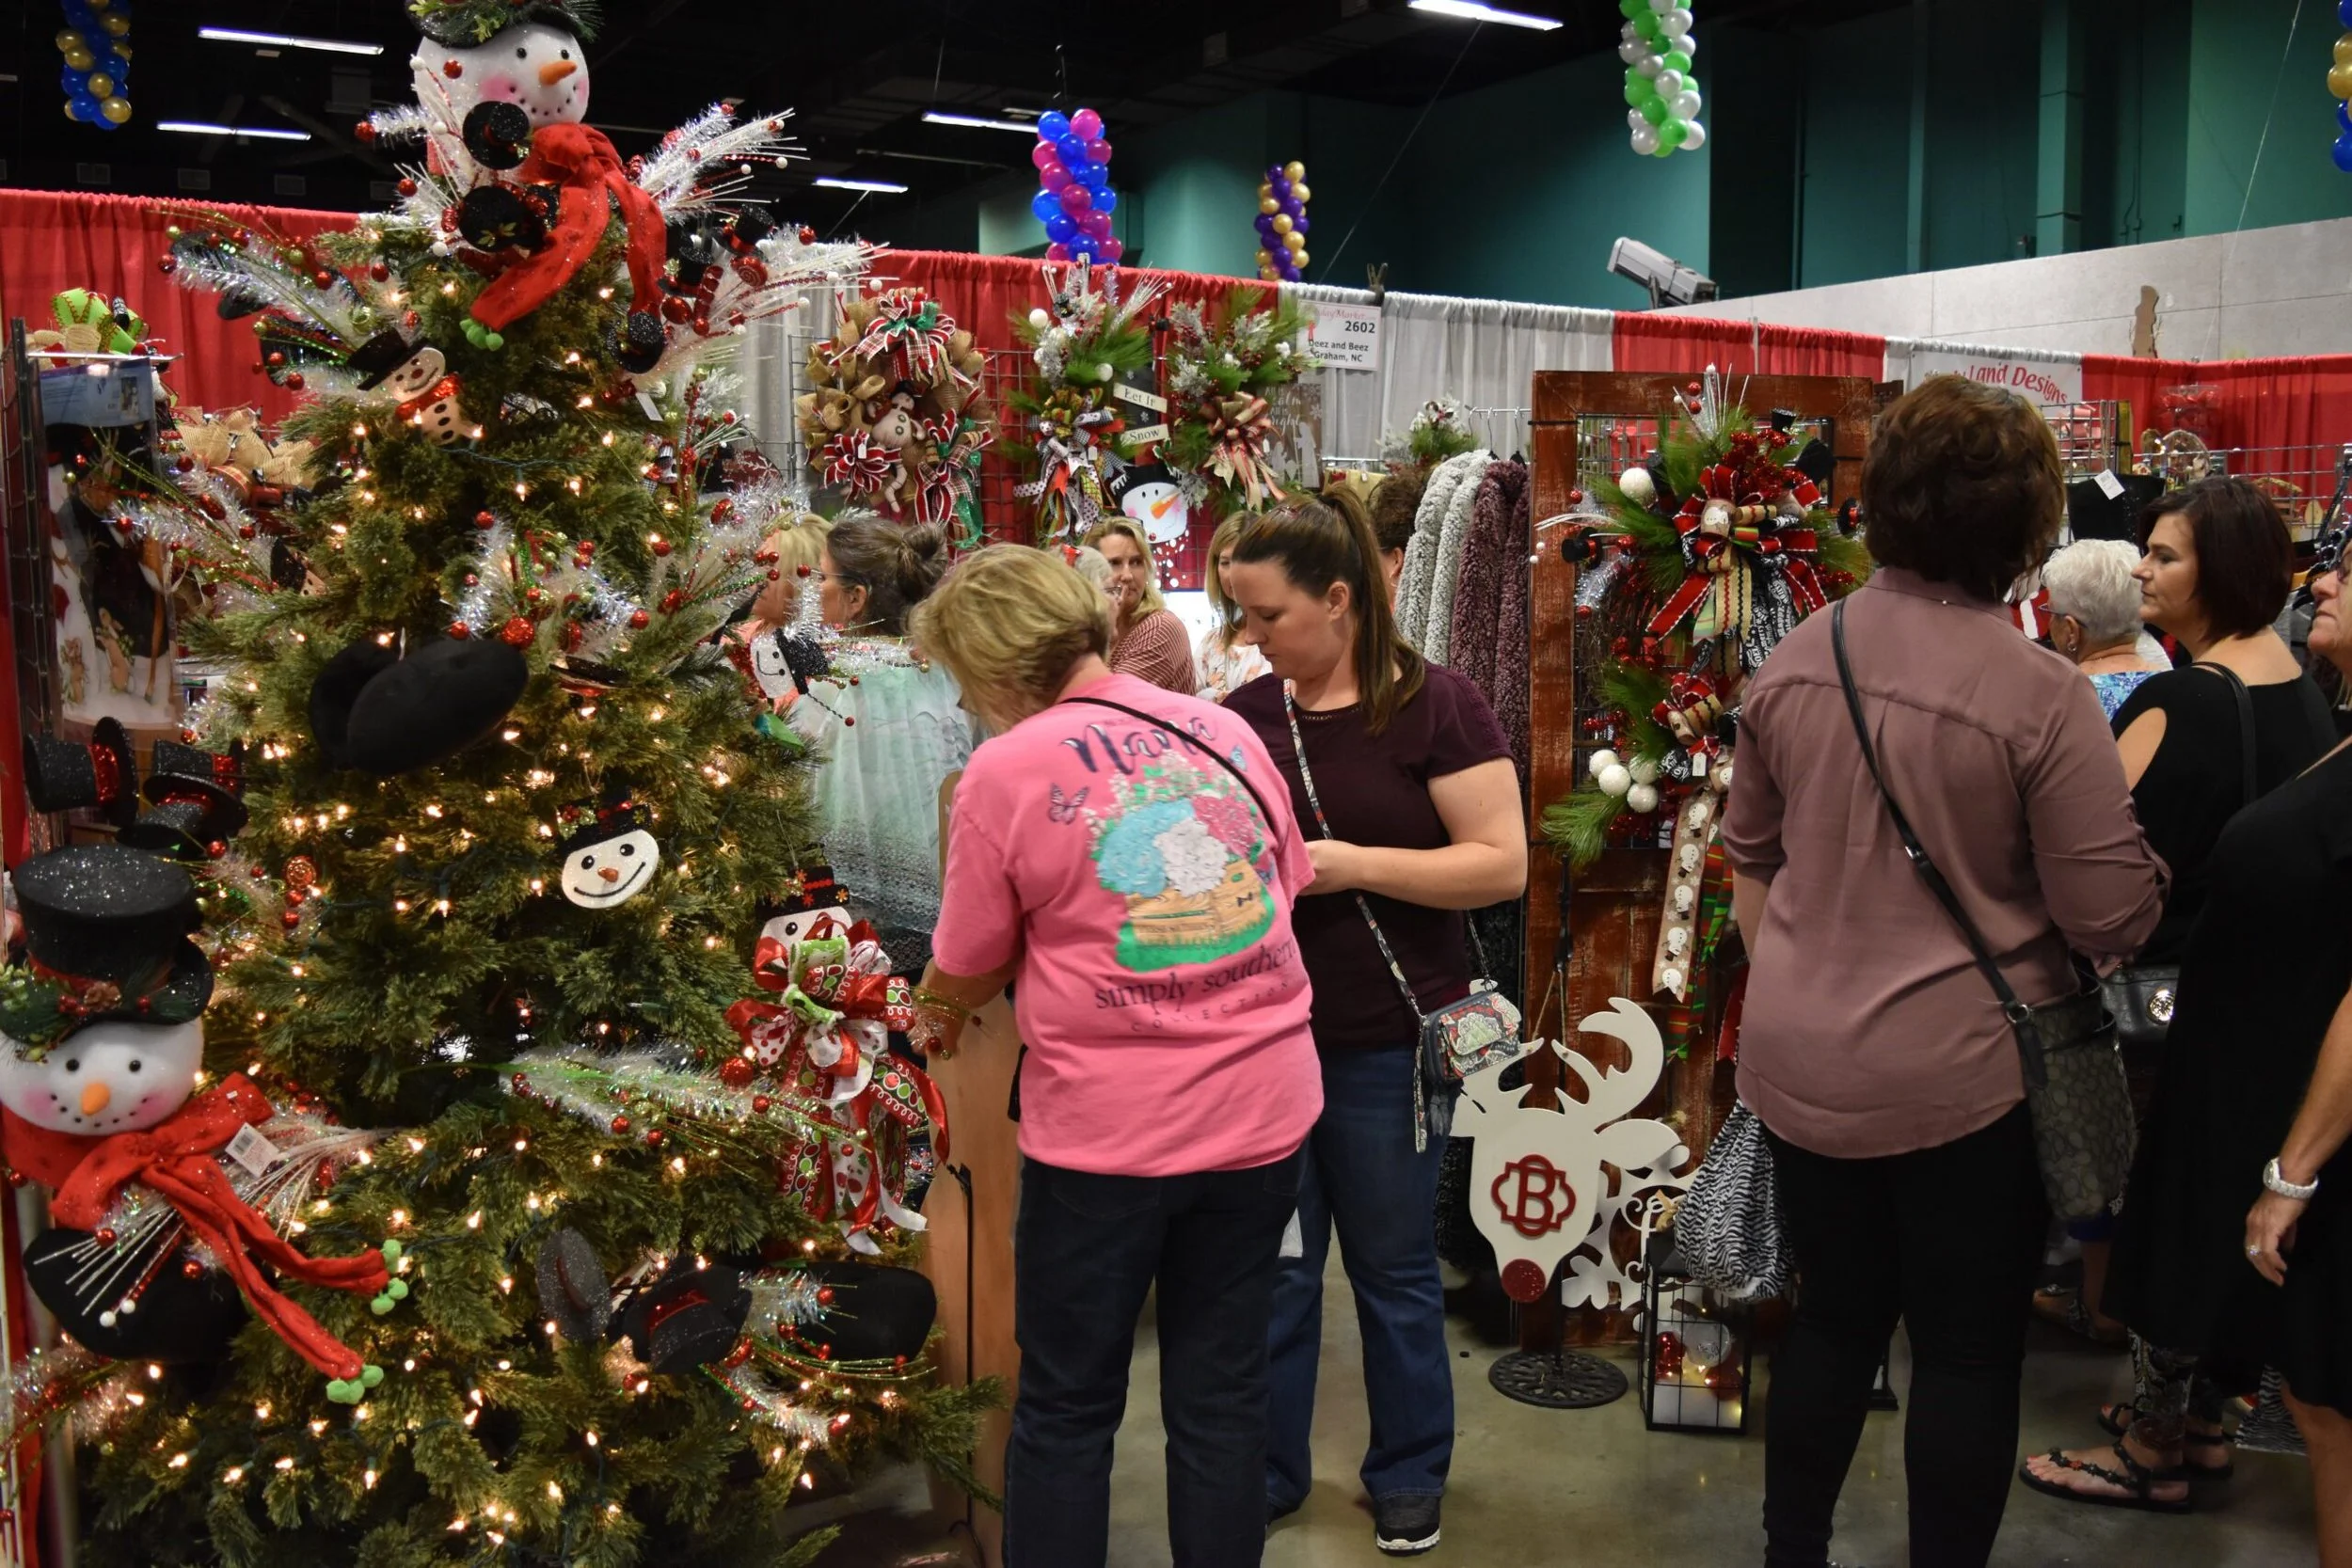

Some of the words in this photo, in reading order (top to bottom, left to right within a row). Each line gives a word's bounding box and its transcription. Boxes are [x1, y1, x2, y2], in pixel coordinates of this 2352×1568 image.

[1344, 321, 1375, 334] 2602
[1331, 341, 1346, 350] and
[1348, 341, 1369, 352] Beez
[1314, 351, 1348, 362] Graham,
[1351, 354, 1362, 363] NC
[2011, 366, 2067, 404] Designs
[1129, 429, 1160, 441] Snow
[1060, 717, 1216, 775] Nana
[1094, 972, 1193, 1015] simply
[1201, 939, 1296, 992] southern
